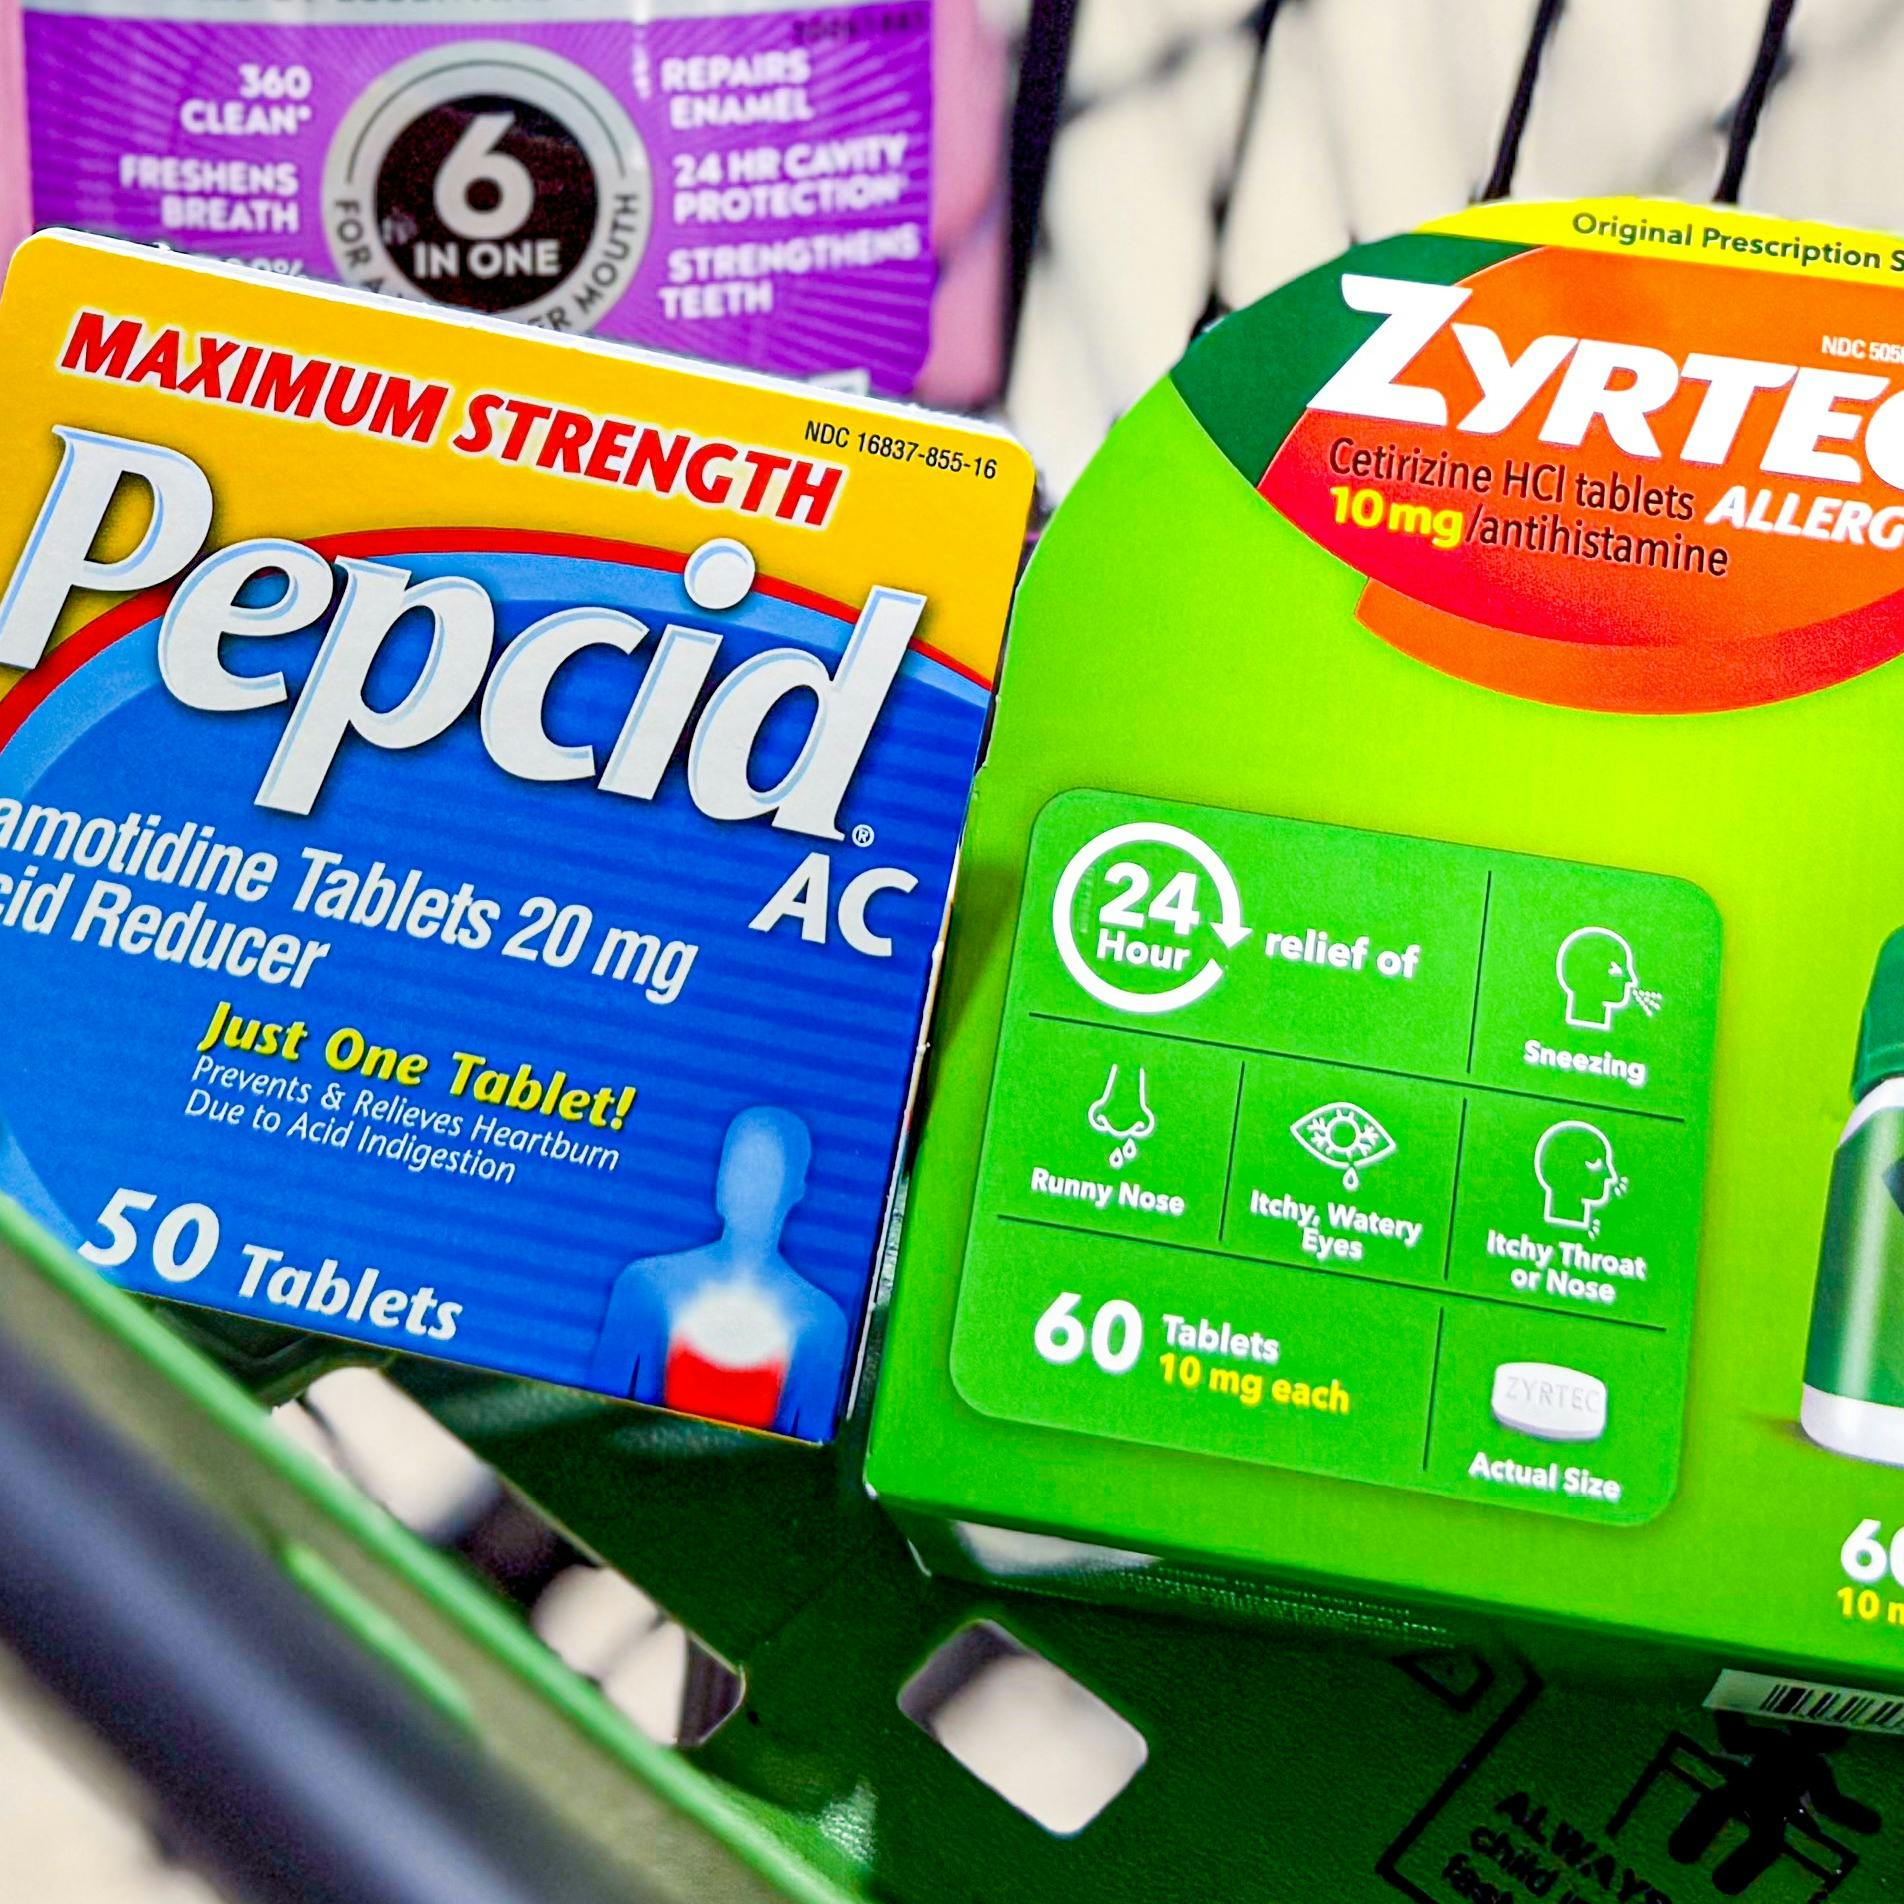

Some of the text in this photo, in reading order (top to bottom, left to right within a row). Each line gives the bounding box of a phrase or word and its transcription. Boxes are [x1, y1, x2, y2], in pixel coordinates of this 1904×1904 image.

[238, 64, 311, 99] 360
[659, 49, 810, 94] REPAIRS
[669, 89, 815, 130] ENAMEL
[119, 153, 300, 196] FRESHENS
[434, 111, 536, 241] 6
[673, 133, 909, 189] 24 HR CAVITY
[159, 196, 300, 234] BREATH
[1572, 211, 1693, 249] Original
[1702, 227, 1882, 271] Prescription
[335, 194, 638, 314] FOR MOUTH
[413, 239, 562, 278] IN ONE
[667, 223, 921, 284] STRENGTHENS
[658, 280, 774, 320] TEETH
[1821, 336, 1868, 358] NDC
[58, 311, 844, 528] MAXIMUM STRENGTH
[804, 419, 998, 480] NDC 16837-855-16
[1327, 437, 1695, 524] Cetirizine HCl tablets
[290, 846, 503, 951] Tablets
[502, 895, 592, 966] 20
[594, 929, 699, 1006] mg
[748, 852, 920, 957] AC
[1098, 862, 1201, 936] 24
[71, 885, 331, 992] Reducer
[1096, 929, 1192, 973] Hour
[1265, 929, 1421, 981] relief of
[197, 1000, 637, 1131] Just One Tablet!
[1522, 1040, 1648, 1087] Sneezing
[184, 1089, 516, 1185] Due to Acid Indigestion
[192, 1055, 620, 1172] Prevents & Relieves Heartburn
[1030, 1166, 1186, 1216] Runny Nose
[1249, 1190, 1423, 1247] Itchy, Watery
[80, 1186, 466, 1343] 50 Tablets
[1301, 1227, 1364, 1261] Eyes
[1485, 1230, 1648, 1281] Itchy Throat
[1510, 1266, 1617, 1305] or Nose
[1033, 1292, 1280, 1374] 60 Tablets
[1159, 1353, 1351, 1416] 10 mg each
[1506, 1376, 1599, 1413] ZYRTEC
[1468, 1452, 1623, 1502] Actual Size
[1837, 1585, 1880, 1621] 10
